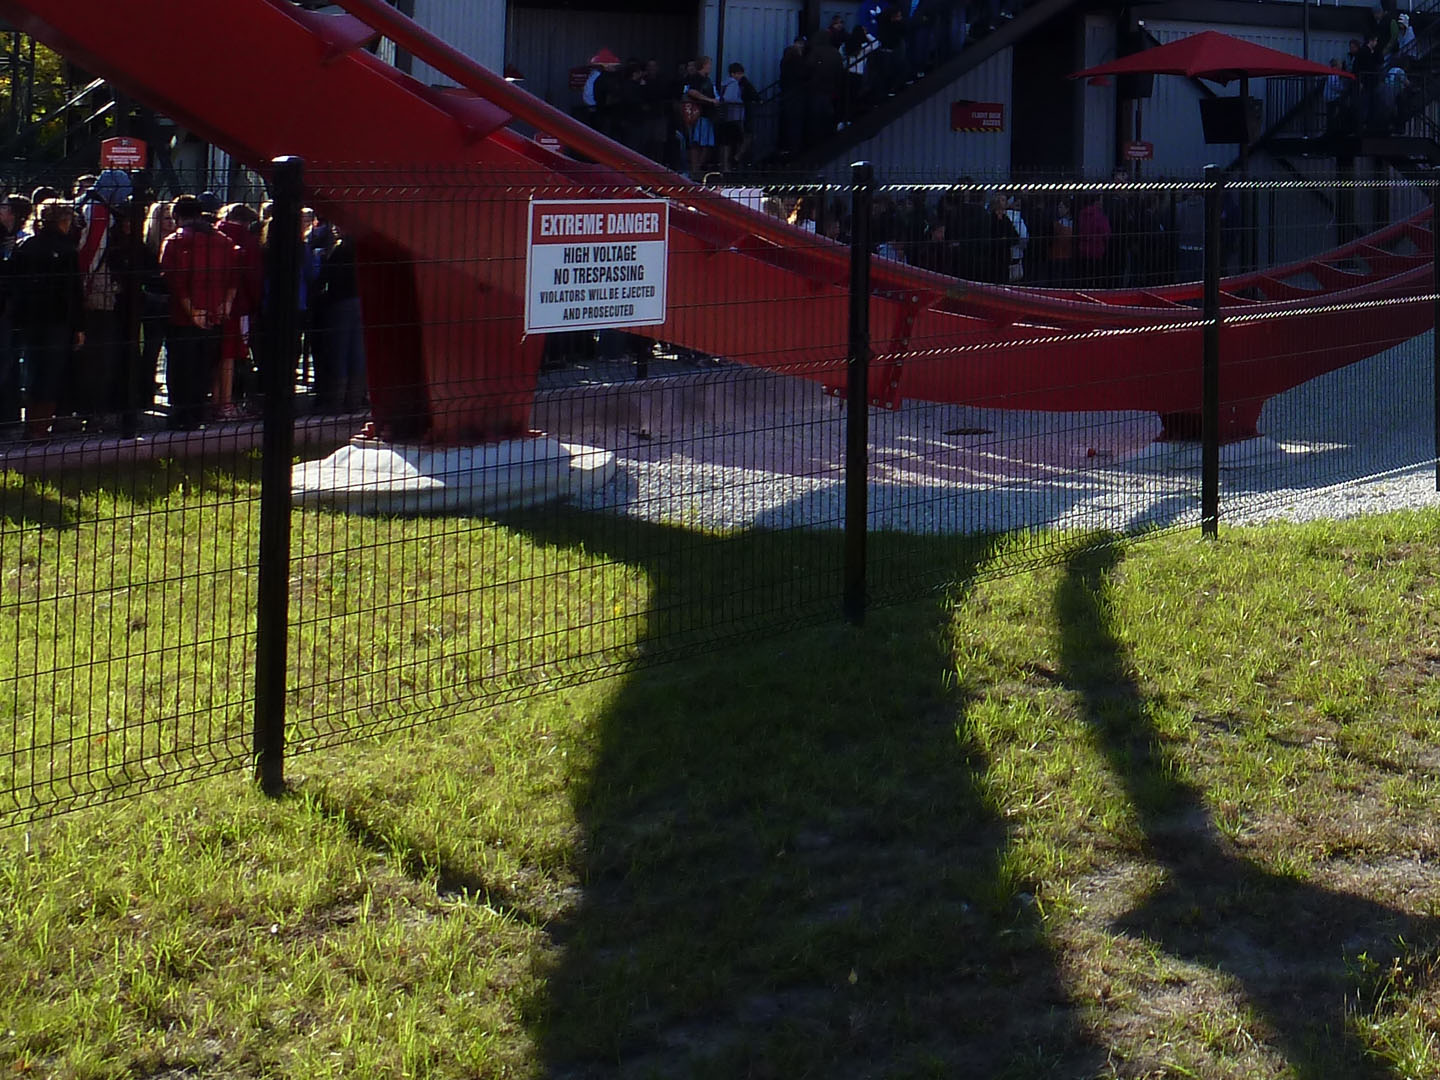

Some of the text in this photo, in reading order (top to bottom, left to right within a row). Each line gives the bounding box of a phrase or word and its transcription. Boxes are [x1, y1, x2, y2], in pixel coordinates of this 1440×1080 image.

[541, 213, 659, 236] EXTREME DANGER
[563, 245, 637, 264] HIGH VOLTAGE
[554, 265, 645, 285] NO TRESPASSING
[540, 285, 655, 304] VIOLATORS WILL BE EJECTED
[563, 304, 634, 320] AND PROSECUTED
